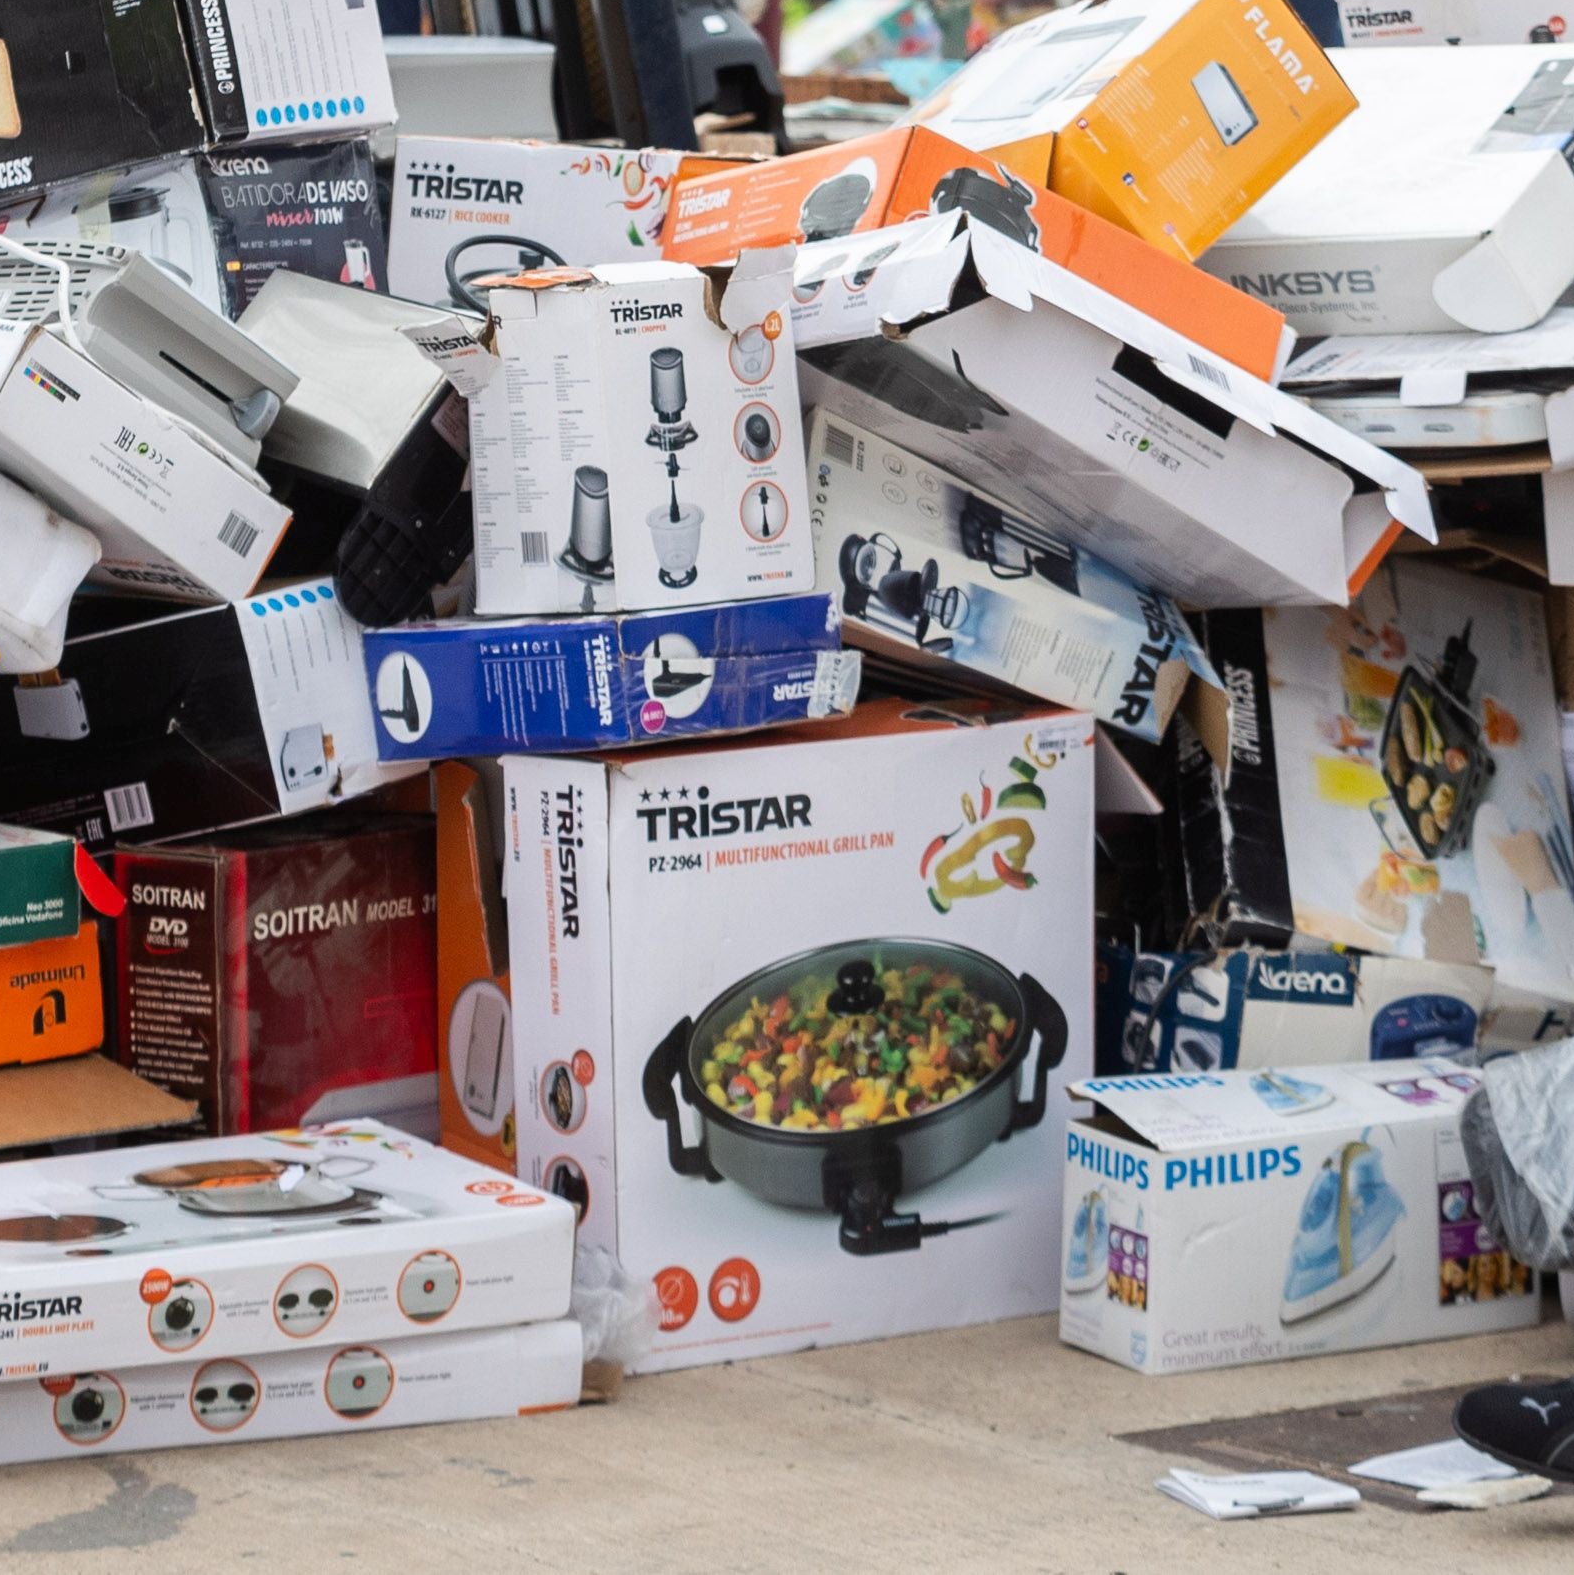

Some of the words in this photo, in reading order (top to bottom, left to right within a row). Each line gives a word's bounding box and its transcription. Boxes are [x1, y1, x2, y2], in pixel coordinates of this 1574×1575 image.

[1243, 6, 1316, 98] FLAMA
[221, 182, 307, 209] BATIDORA
[307, 181, 329, 205] DE
[330, 179, 368, 203] VASO
[454, 210, 475, 223] RICE
[476, 211, 511, 225] COOKER
[1231, 269, 1376, 297] INKSYS
[1278, 302, 1310, 315] Cisco
[648, 853, 703, 874] PZ-2964
[714, 837, 830, 868] MULTIFUNCTIONAL
[833, 833, 866, 854] GRILL
[868, 830, 895, 851] PAN
[27, 900, 43, 913] Neo
[132, 883, 206, 911] SOITRAN
[26, 909, 64, 924] Vodafone
[148, 916, 189, 937] DVD
[253, 898, 359, 941] SOITRAN
[366, 896, 415, 922] MODEL
[421, 893, 437, 916] 31
[9, 963, 86, 989] Unimade
[1066, 1131, 1150, 1191] PHILIPS
[1163, 1144, 1303, 1192] PHILIPS
[21, 1326, 54, 1338] DOUBLE
[72, 1320, 95, 1333] PLATE
[1161, 1328, 1207, 1350] Great
[1160, 1343, 1235, 1369] minimum
[1236, 1338, 1283, 1362] effort
